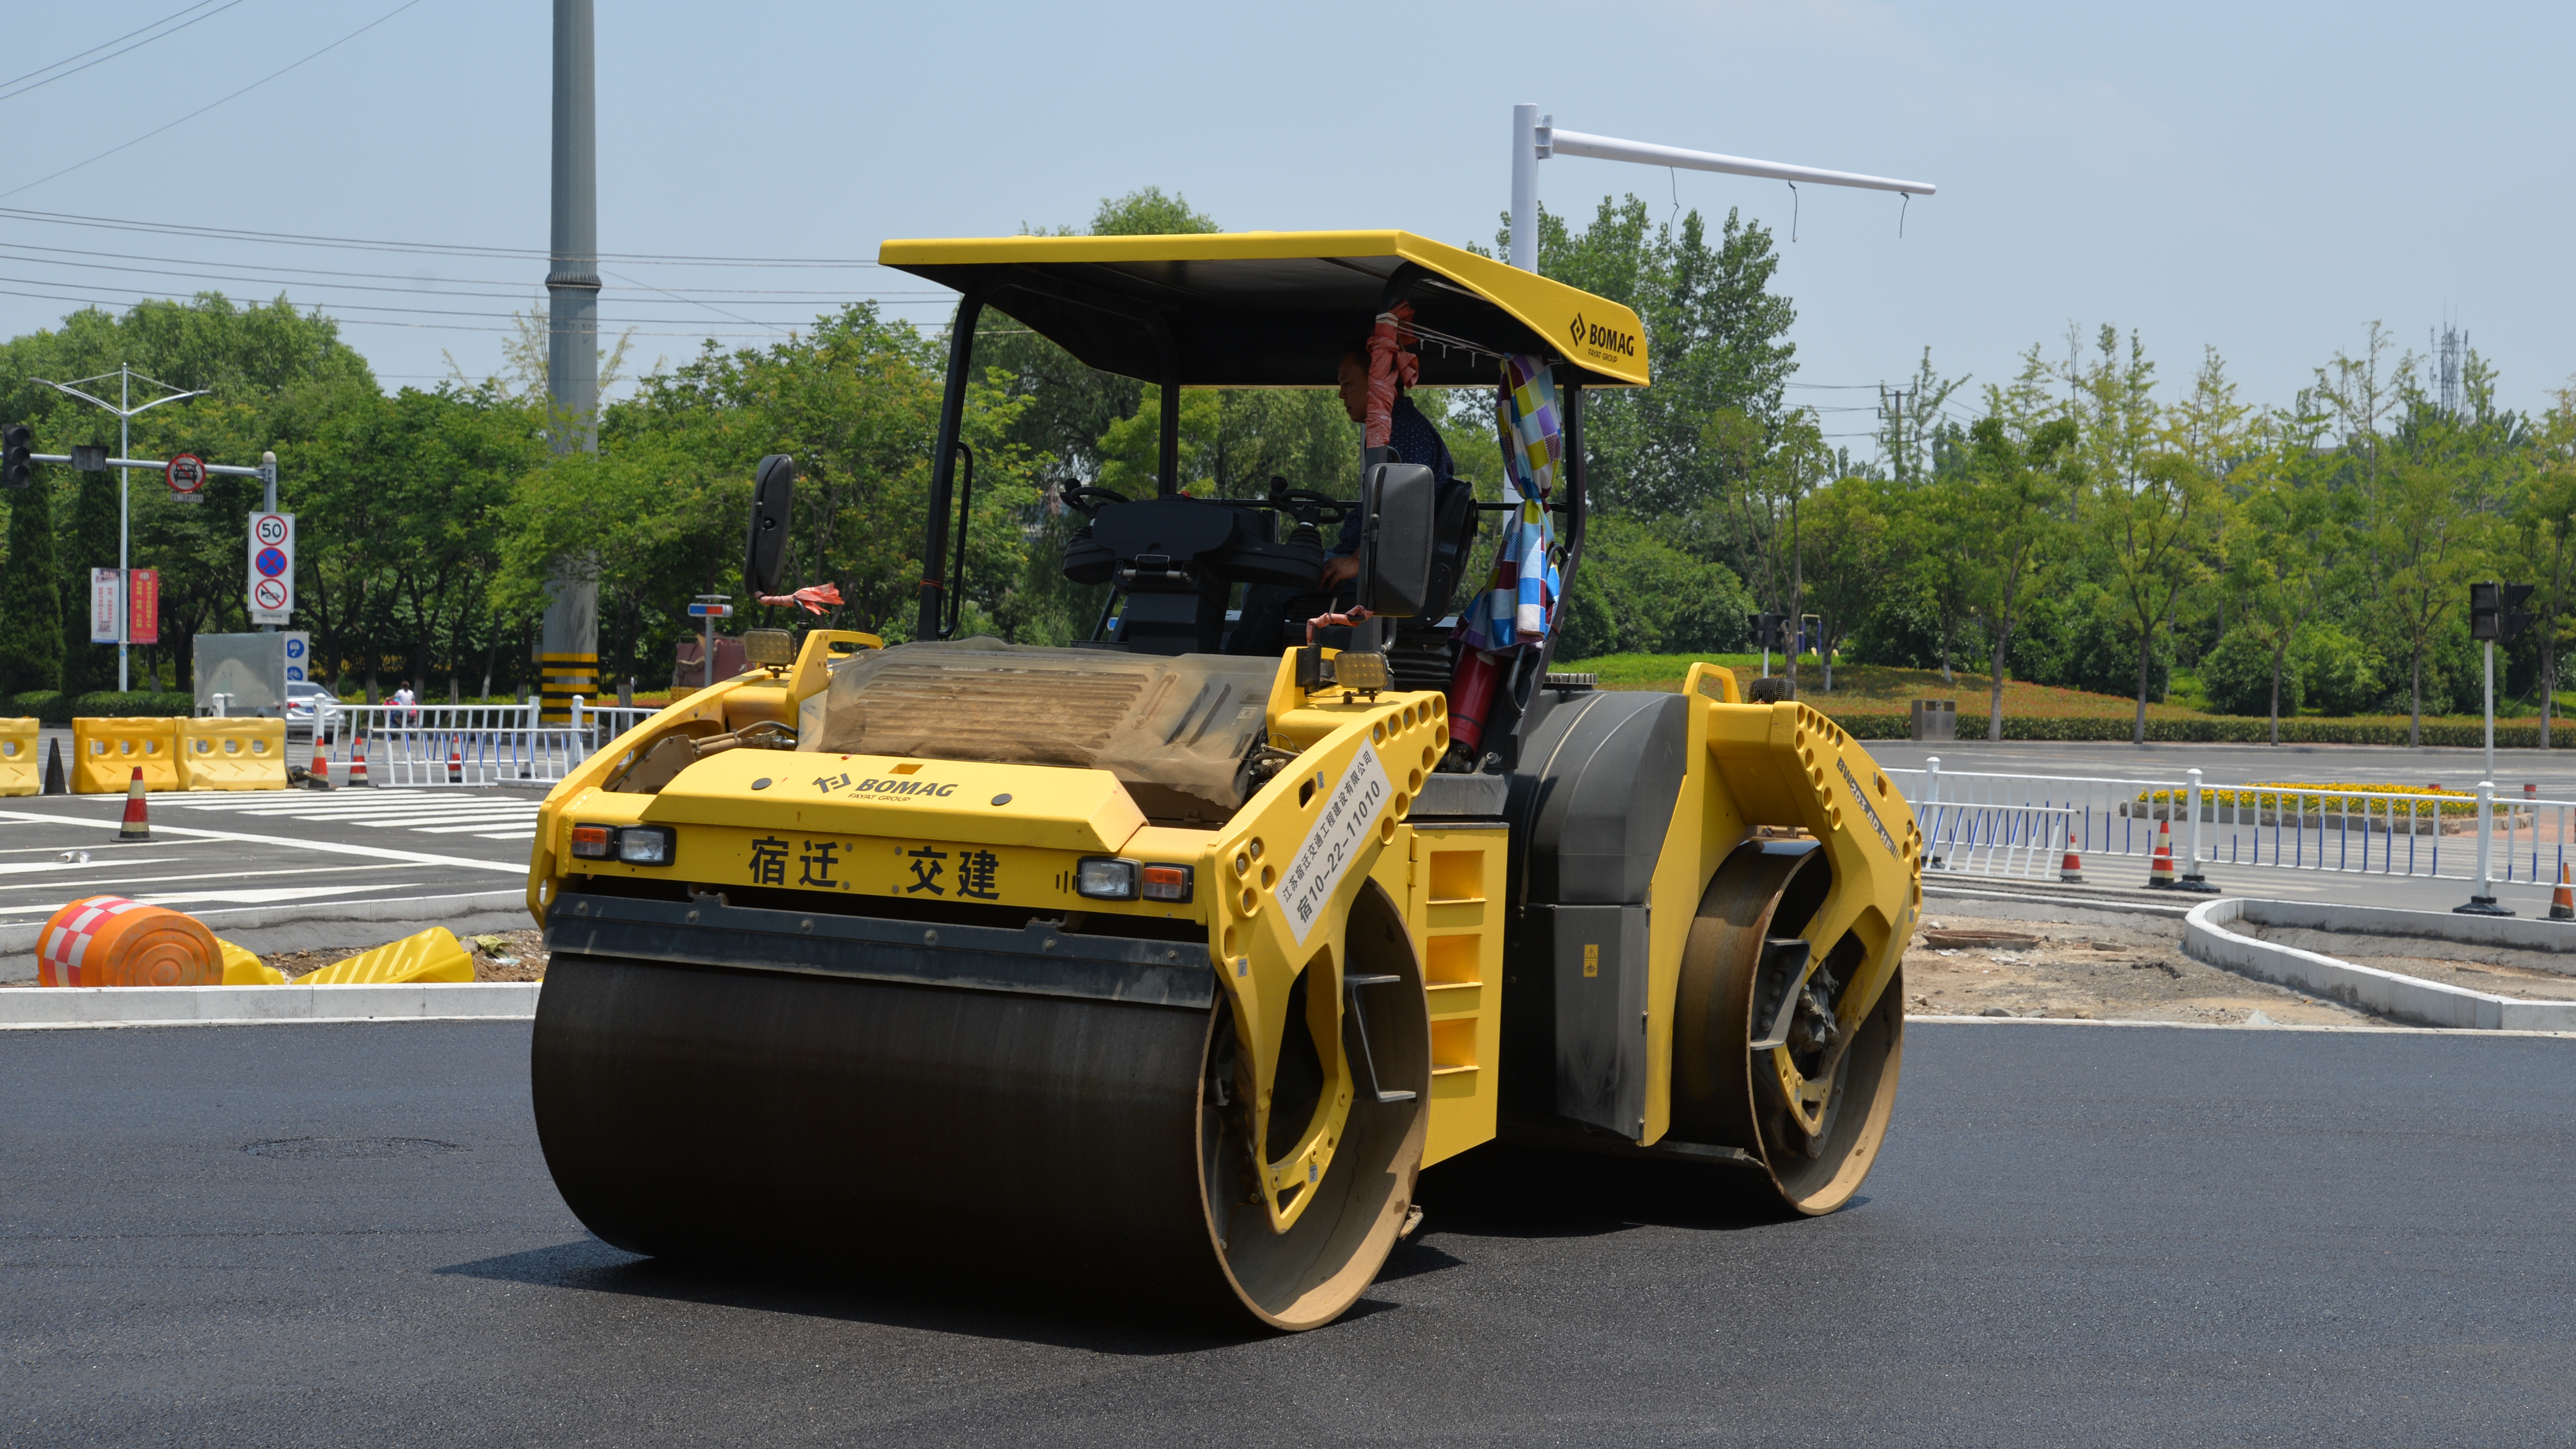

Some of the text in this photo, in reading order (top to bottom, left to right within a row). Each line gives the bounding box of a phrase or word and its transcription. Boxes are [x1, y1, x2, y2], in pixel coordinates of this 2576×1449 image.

[1588, 348, 1618, 363] FAYAT GROUP
[1589, 323, 1634, 357] BOMAG
[262, 523, 282, 538] 50
[855, 779, 959, 797] BOMAG
[1282, 750, 1372, 903] 江苏宿迁交通工程建设有限公司
[1866, 810, 1879, 832] AD
[1880, 830, 1892, 850] HF
[748, 836, 1001, 900] 宿迁 交建
